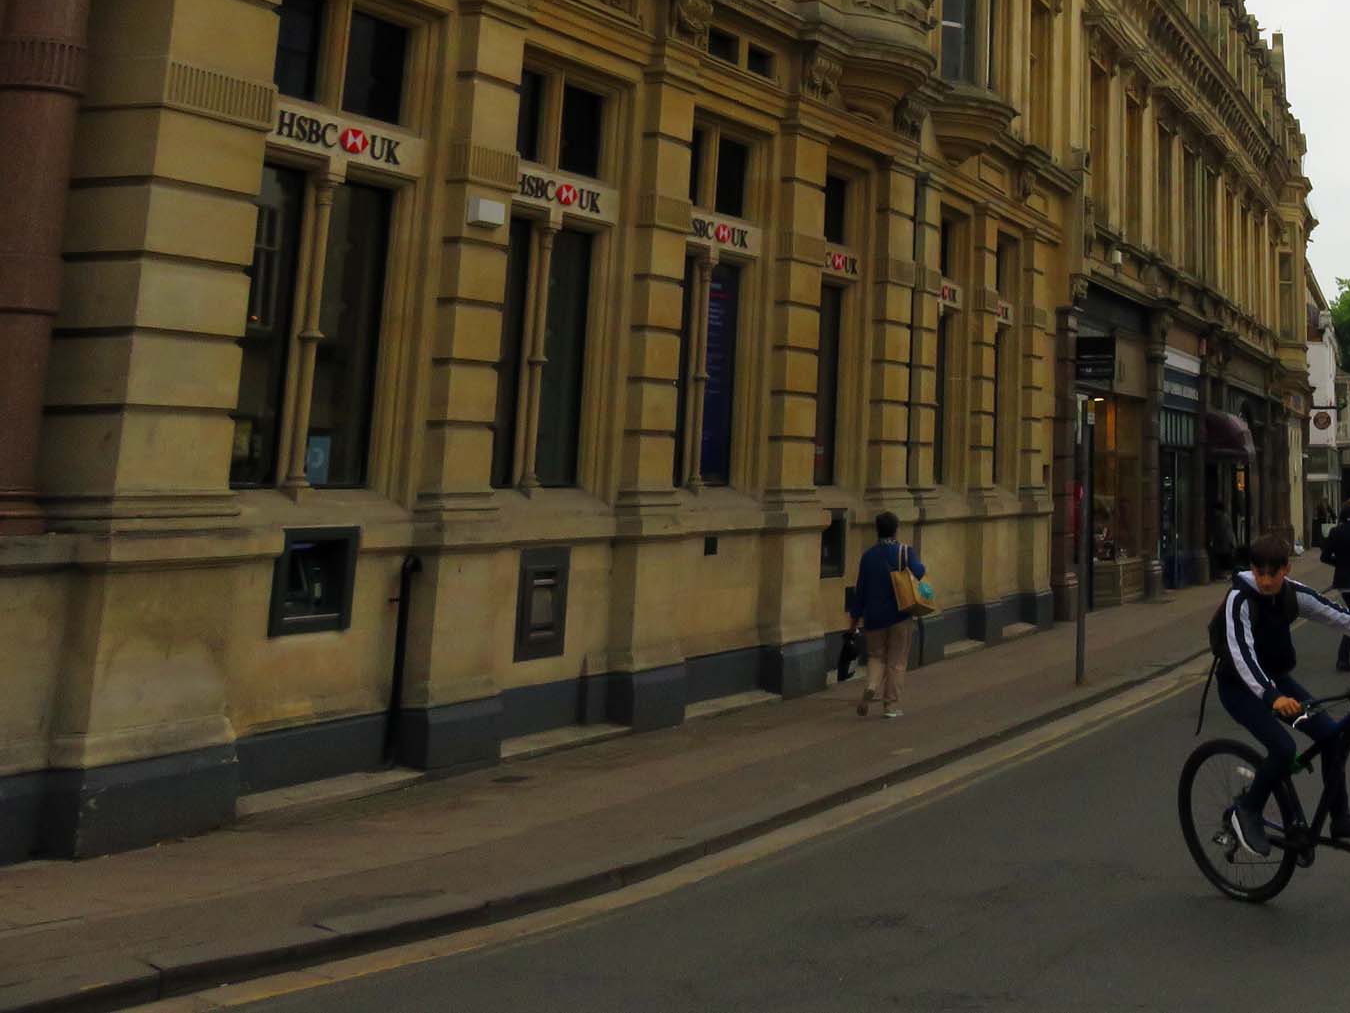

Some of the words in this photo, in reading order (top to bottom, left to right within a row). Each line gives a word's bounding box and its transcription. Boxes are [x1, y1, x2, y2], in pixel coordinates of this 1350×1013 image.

[276, 110, 338, 148] HSBC
[370, 134, 401, 165] UK
[578, 188, 601, 214] UK
[731, 228, 748, 248] UK
[844, 255, 858, 275] UK
